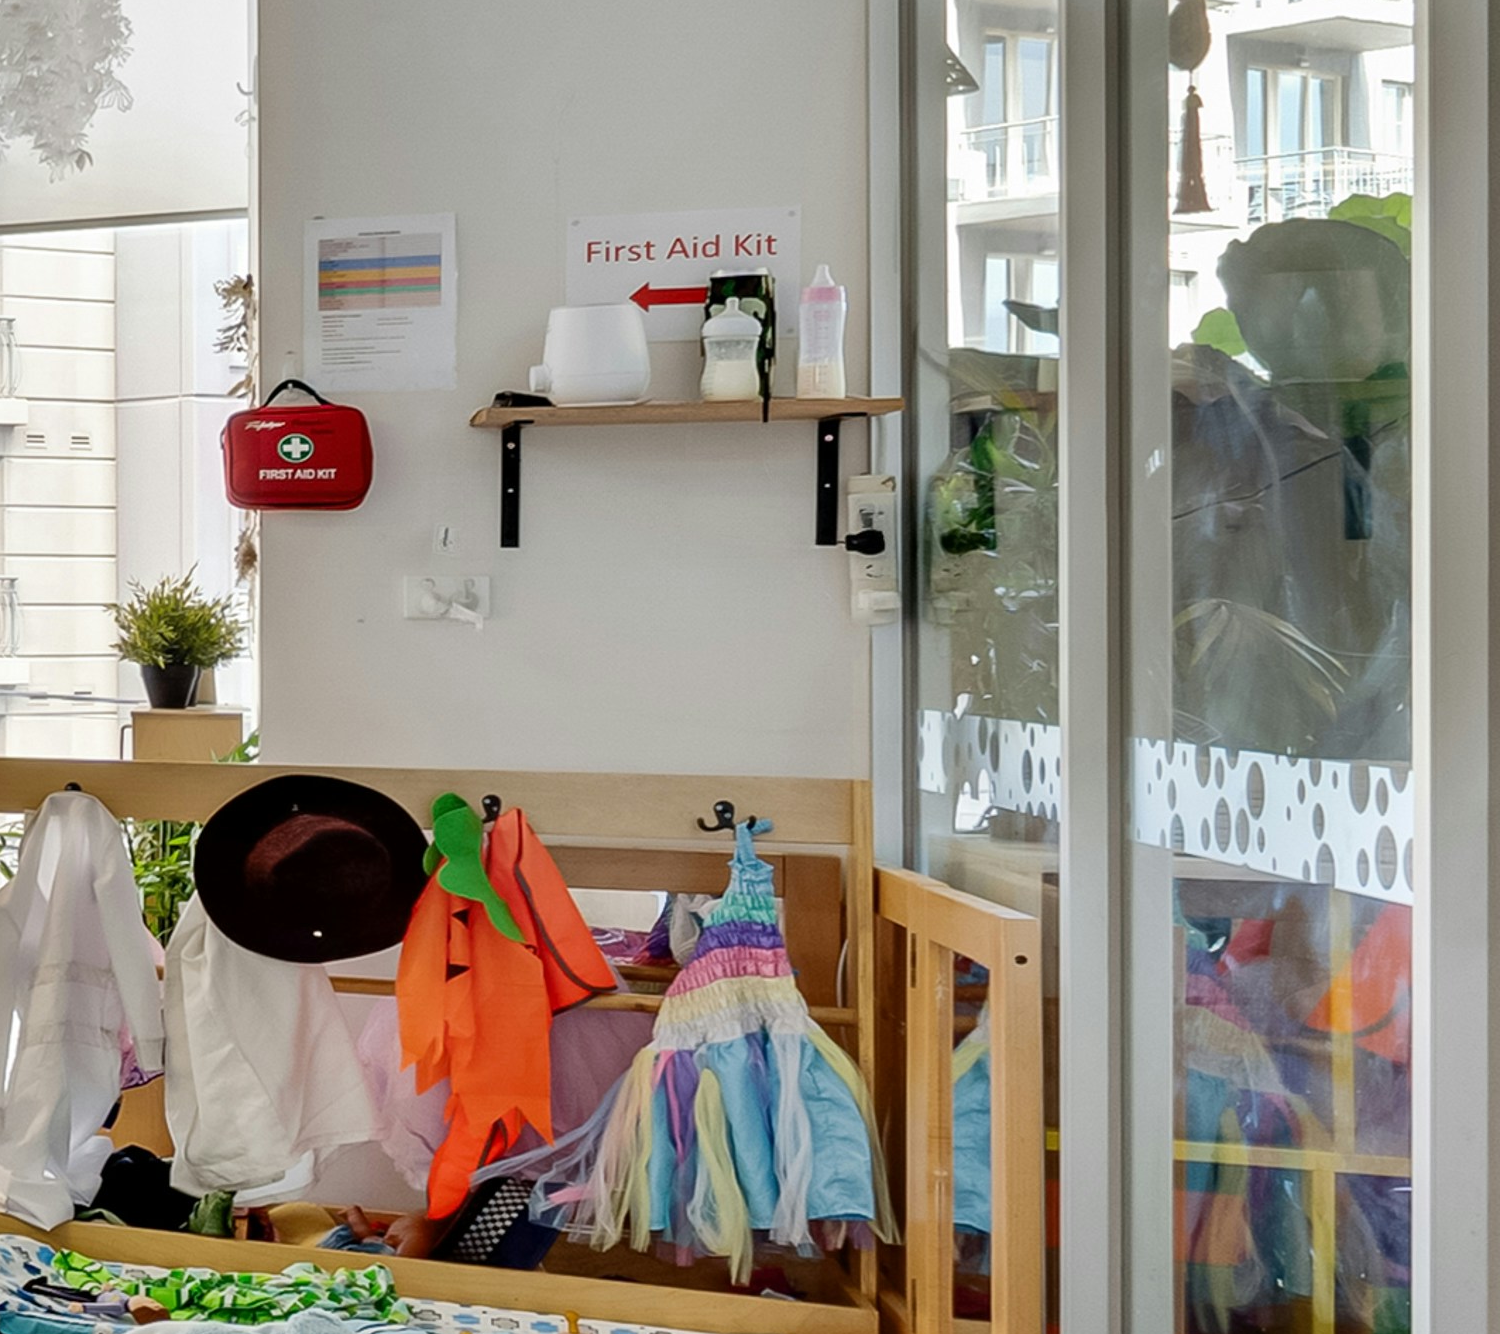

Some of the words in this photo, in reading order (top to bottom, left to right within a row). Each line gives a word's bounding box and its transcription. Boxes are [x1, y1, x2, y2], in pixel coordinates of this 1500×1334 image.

[585, 240, 657, 264] First
[666, 234, 721, 260] Aid
[733, 233, 778, 257] Kit
[258, 469, 294, 481] FIRST
[294, 468, 316, 480] AID
[317, 468, 337, 480] KIT
